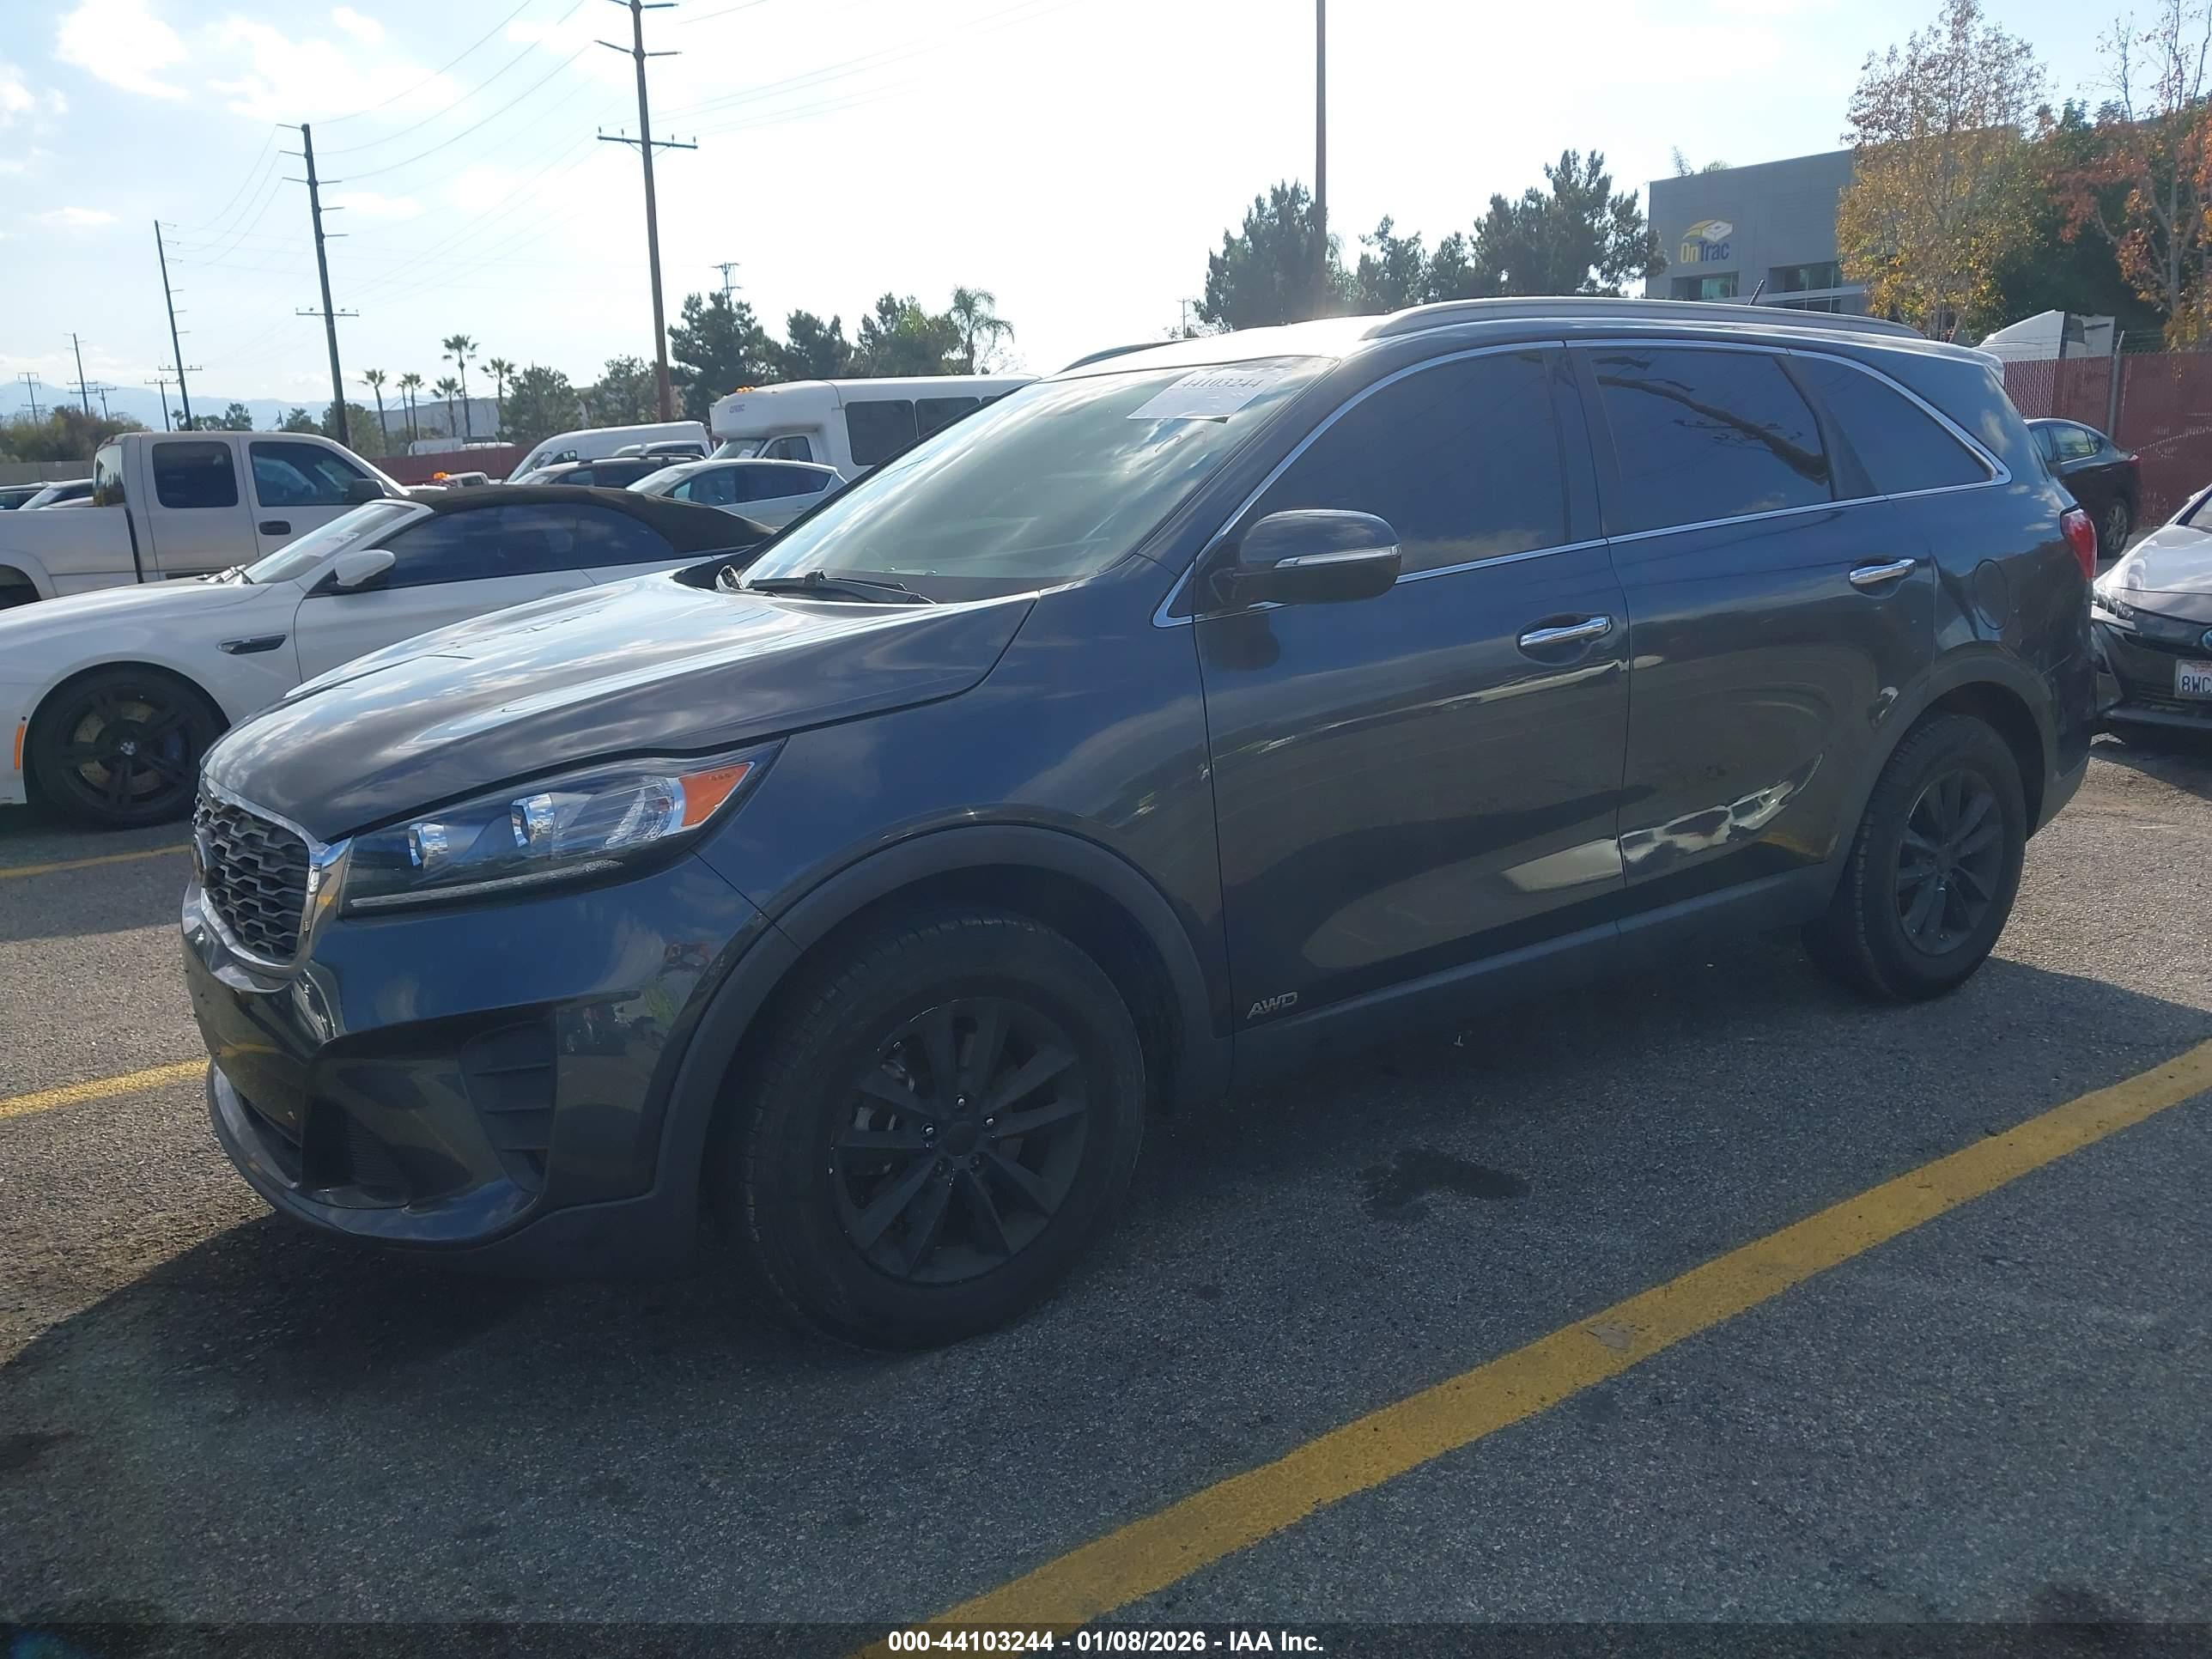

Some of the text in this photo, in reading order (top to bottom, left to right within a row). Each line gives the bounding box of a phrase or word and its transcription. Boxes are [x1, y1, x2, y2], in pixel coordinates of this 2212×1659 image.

[1680, 240, 1729, 263] OnTrac
[1182, 378, 1264, 388] 44103244
[1247, 992, 1297, 1018] AWD
